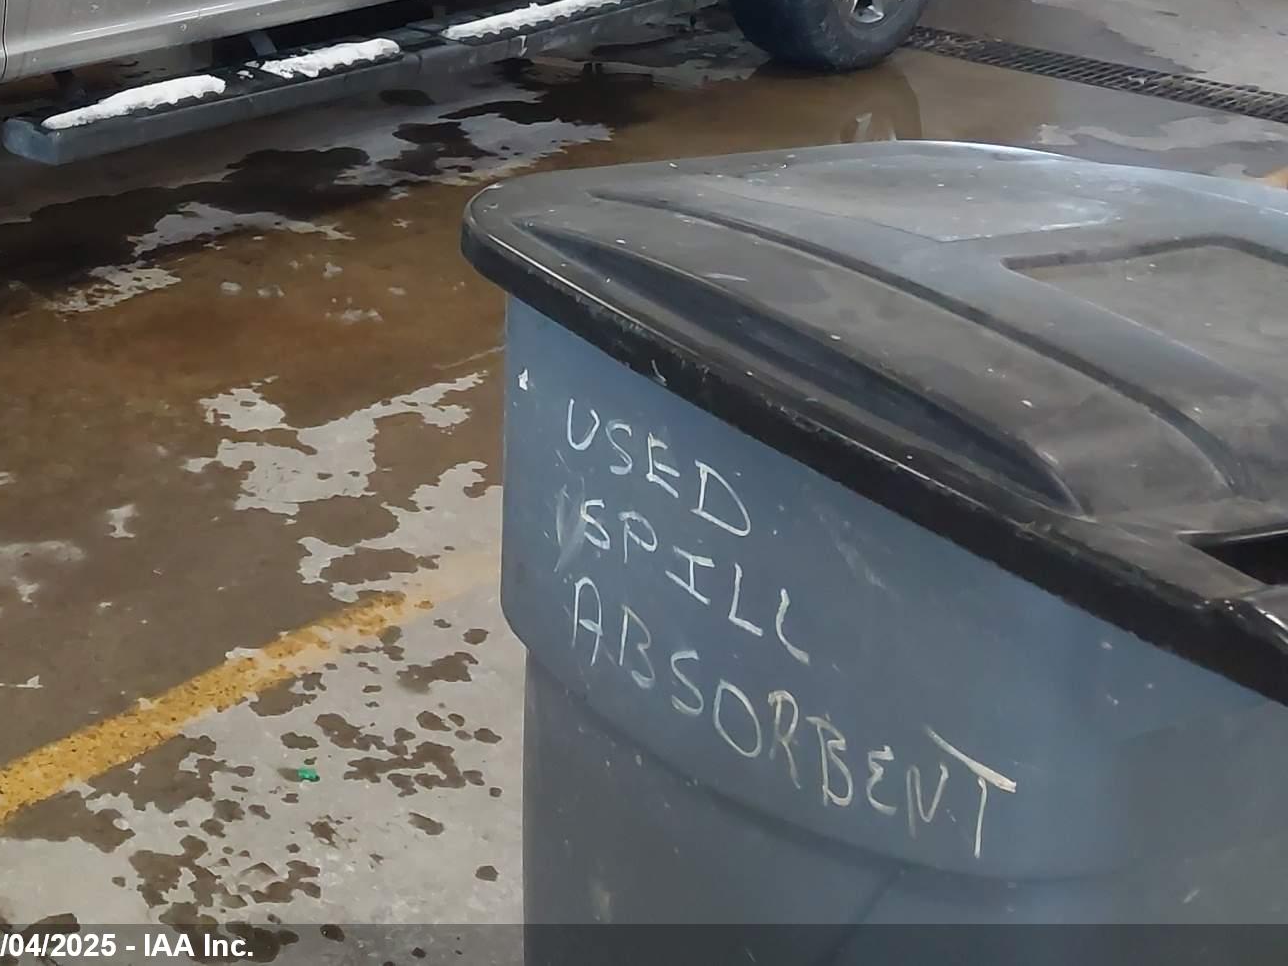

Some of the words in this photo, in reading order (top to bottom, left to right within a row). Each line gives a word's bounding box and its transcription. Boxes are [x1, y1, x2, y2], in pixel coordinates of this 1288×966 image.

[566, 398, 752, 537] USED
[579, 497, 810, 665] SPILL
[571, 576, 1017, 859] ABSORBENT
